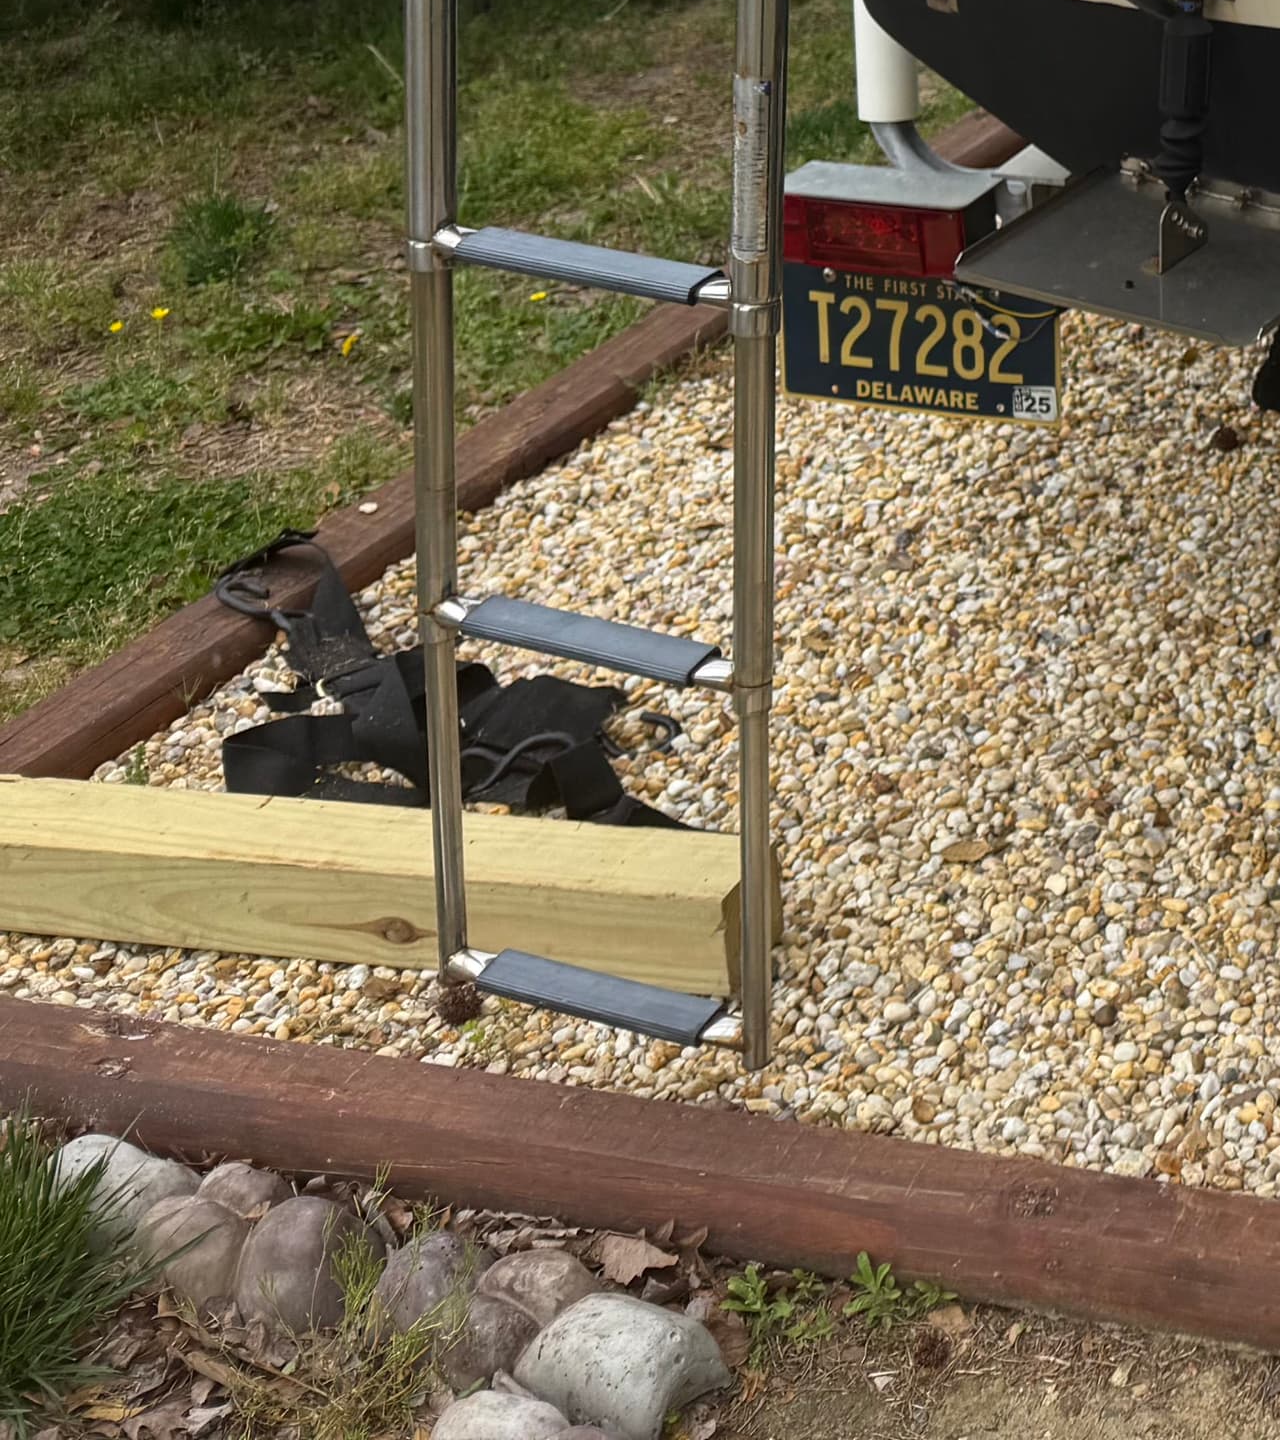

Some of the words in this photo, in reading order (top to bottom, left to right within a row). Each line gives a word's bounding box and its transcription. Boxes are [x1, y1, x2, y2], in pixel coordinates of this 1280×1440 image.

[845, 274, 875, 292] THE
[884, 279, 927, 297] FIRST
[808, 290, 1024, 385] T27282
[856, 379, 980, 410] DELAWARE
[1024, 396, 1051, 414] 25
